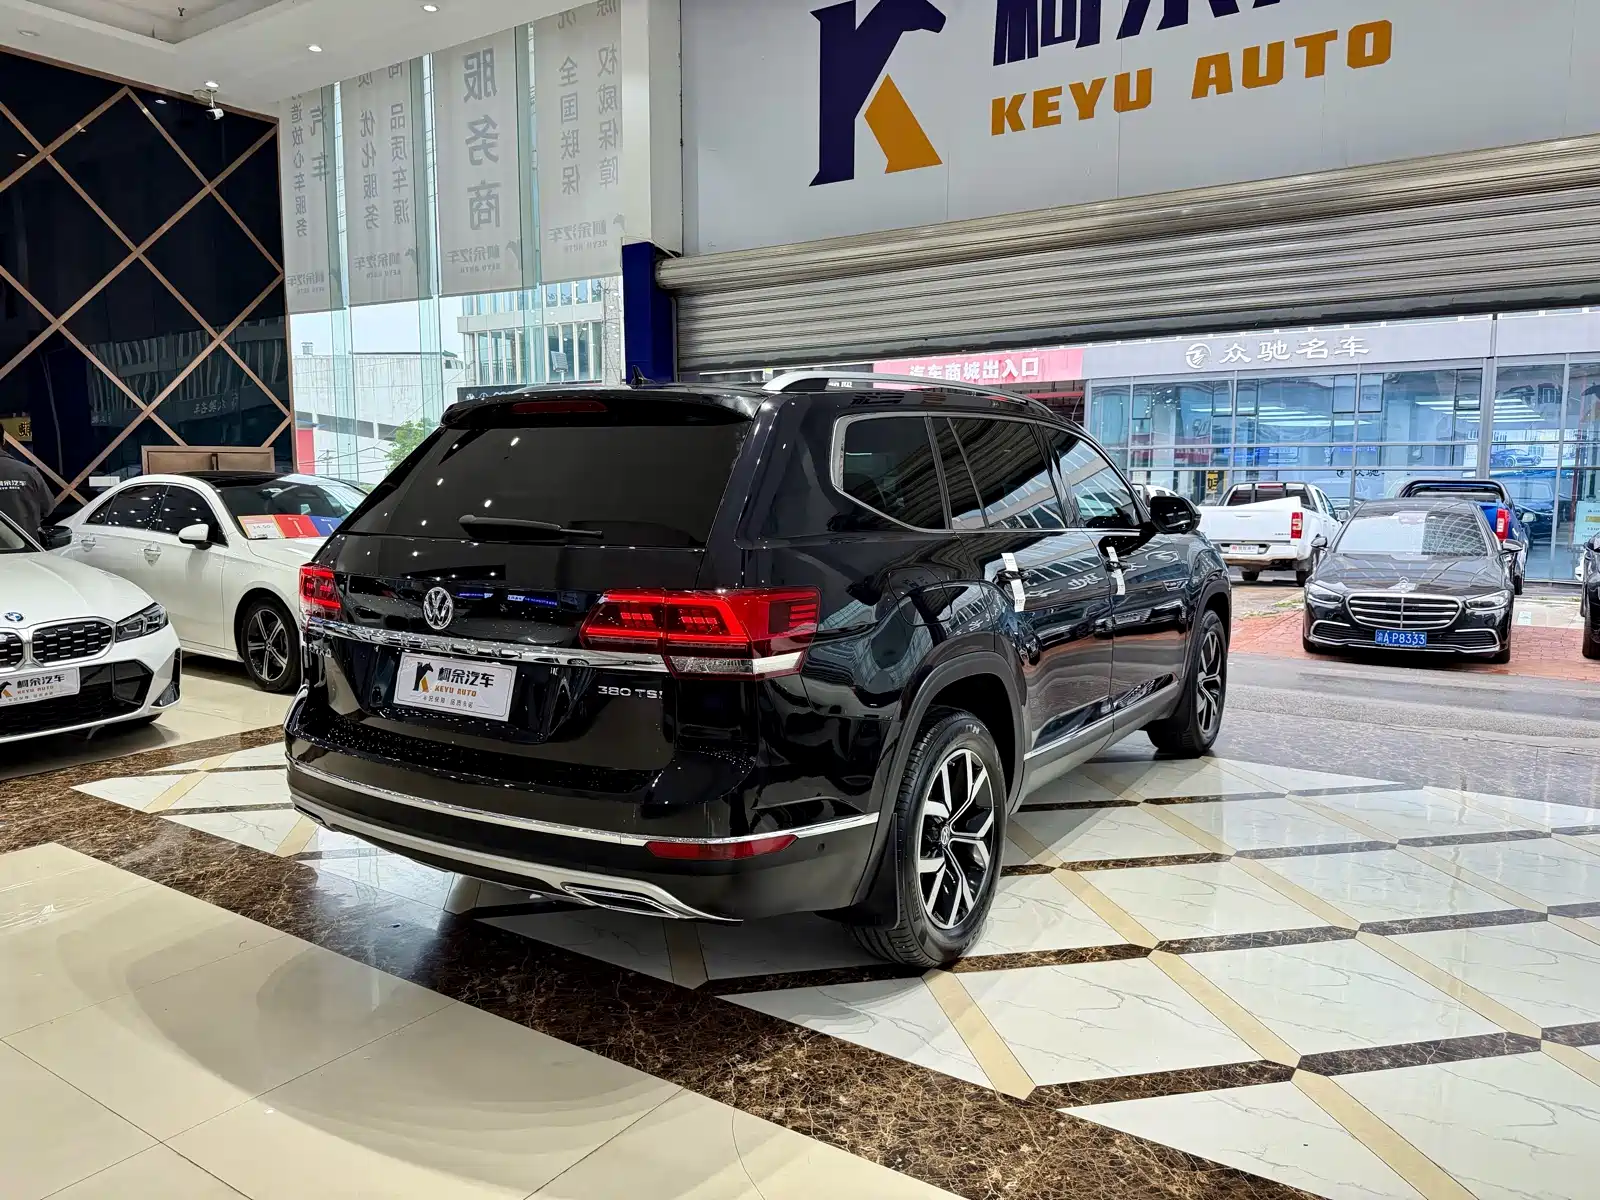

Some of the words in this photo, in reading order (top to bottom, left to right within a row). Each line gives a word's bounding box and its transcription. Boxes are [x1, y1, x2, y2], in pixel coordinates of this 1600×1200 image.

[991, 68, 1153, 137] KEYU
[1191, 19, 1393, 100] AUTO
[1219, 335, 1370, 365] 众驰名车
[909, 357, 1009, 381] 汽车商城出入口
[434, 684, 454, 694] KEYU
[456, 688, 477, 697] AUTO
[597, 685, 632, 697] 380
